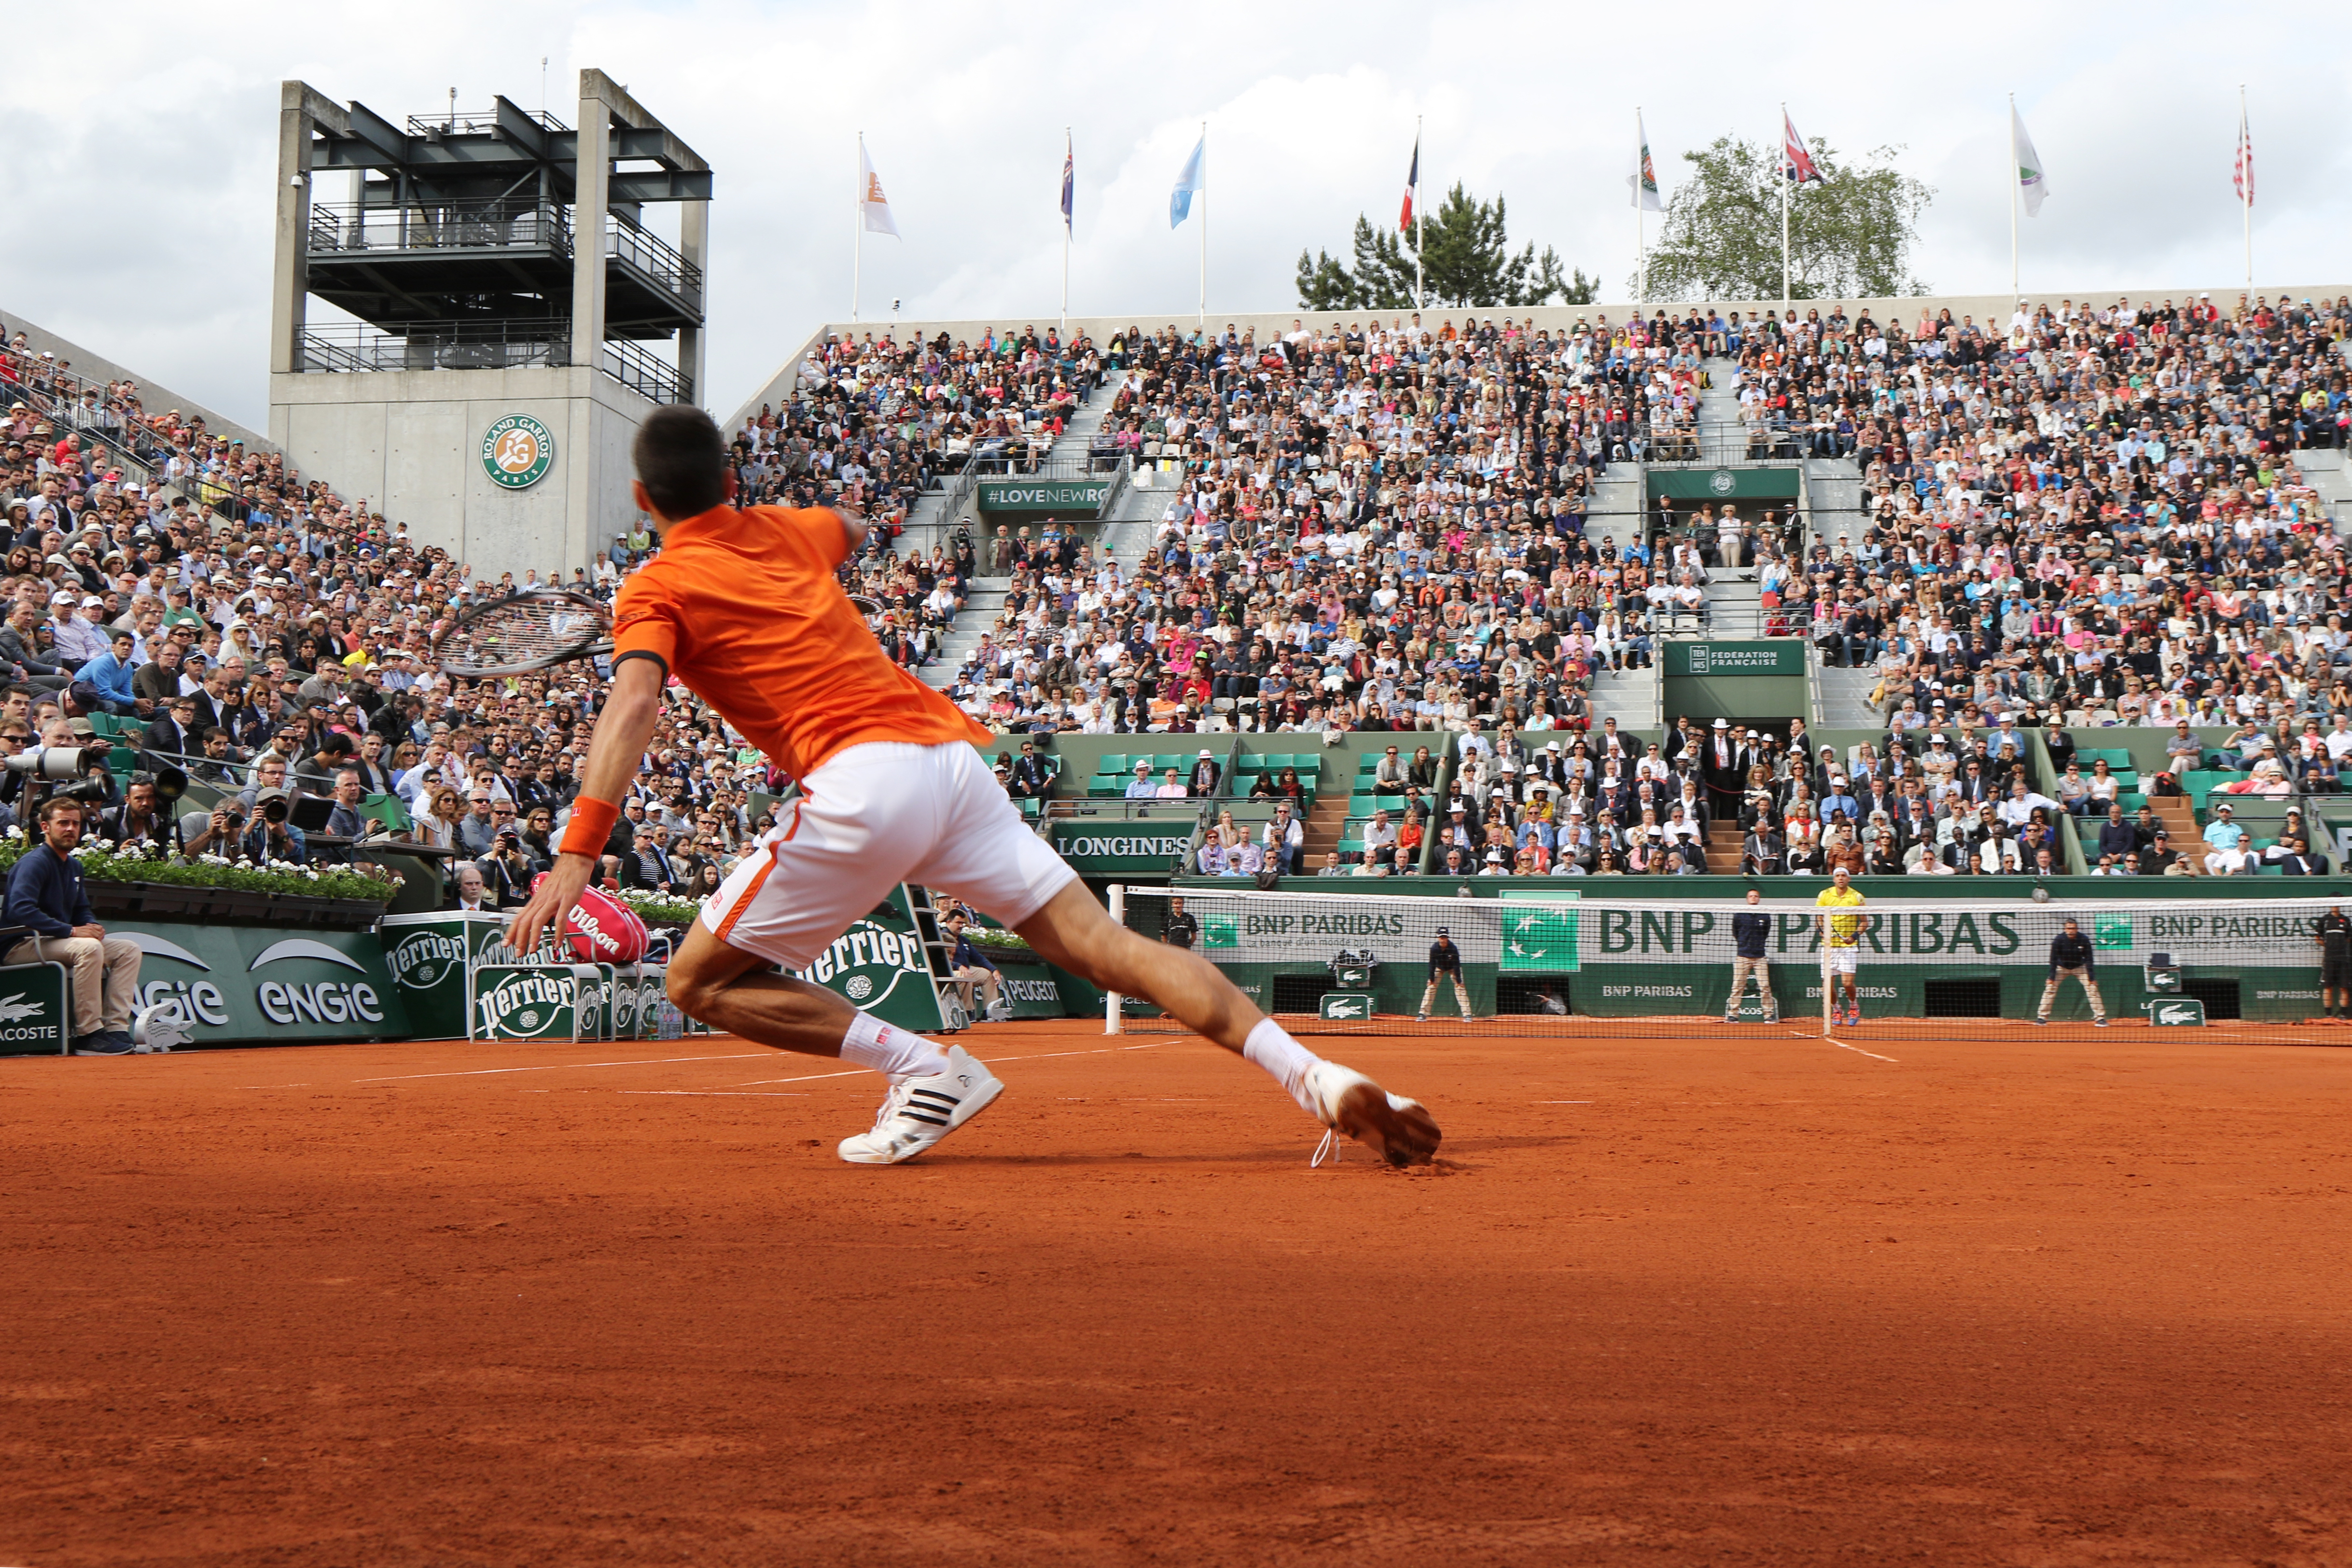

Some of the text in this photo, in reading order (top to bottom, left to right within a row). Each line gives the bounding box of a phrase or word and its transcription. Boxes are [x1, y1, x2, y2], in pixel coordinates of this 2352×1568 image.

[484, 418, 549, 459] ROLAND GARROS
[493, 469, 538, 483] PARIS
[1693, 649, 1705, 657] TEN
[1711, 651, 1778, 659] FÉDÉRATION
[1693, 661, 1705, 669] NIS
[1057, 837, 1192, 856] LONGINES
[568, 904, 620, 955] Wilson
[1247, 915, 1403, 935] BNP PARIBAS
[1600, 909, 2019, 955] BNP PRIBAS
[2152, 916, 2320, 936] BNP PARIBAS
[1320, 937, 1350, 946] monde
[1008, 980, 1060, 1001] PEUGEOT
[1602, 985, 1692, 998] BNP PARIBAS
[1838, 987, 1897, 998] PRIBAS
